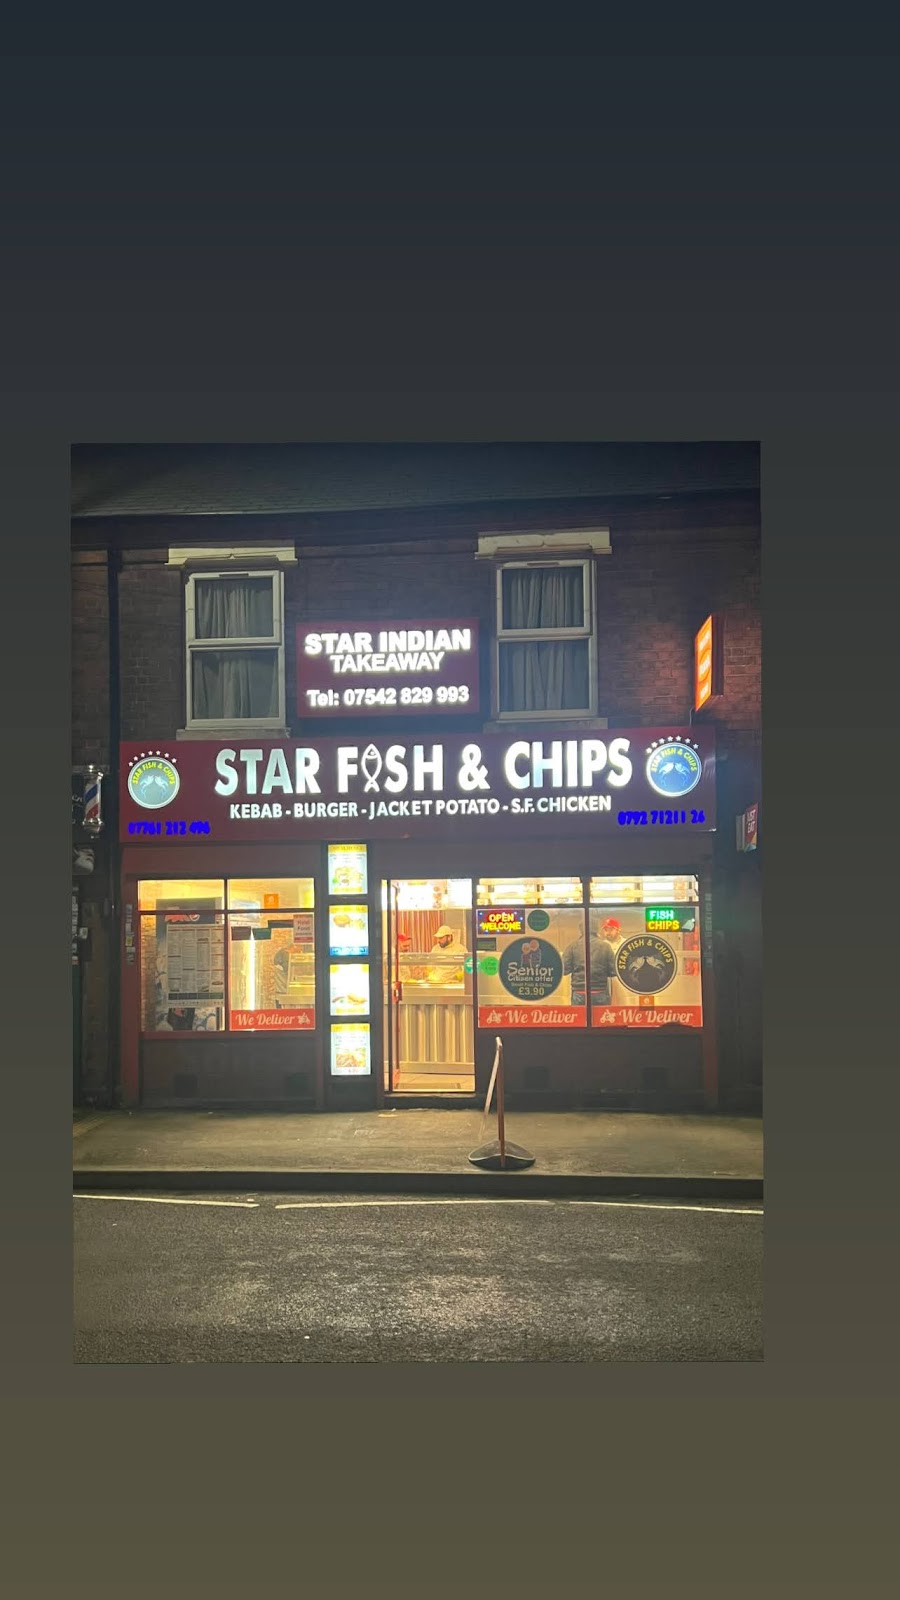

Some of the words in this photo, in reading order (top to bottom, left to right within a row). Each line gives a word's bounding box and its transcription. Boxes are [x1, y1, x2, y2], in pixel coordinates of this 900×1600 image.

[305, 632, 373, 654] STAR
[379, 629, 471, 652] INDIAN
[330, 652, 445, 673] TAKEAWAY
[306, 689, 339, 707] Tel:
[343, 687, 397, 706] 07542
[400, 686, 433, 704] 829
[436, 685, 470, 704] 993
[661, 747, 676, 758] FISH
[684, 752, 698, 771] CHIPS
[132, 767, 143, 785] STAR
[142, 761, 157, 771] FISH
[163, 766, 176, 785] CHIPS
[214, 749, 321, 796] STAR
[457, 744, 490, 792] &
[503, 738, 632, 790] CHIPS
[230, 803, 282, 819] KEBAB
[293, 802, 358, 818] BURGER
[368, 800, 433, 820] JACKET
[436, 798, 500, 816] POTATO
[537, 795, 612, 813] CHICKEN
[488, 913, 514, 922] OPEN
[649, 910, 674, 920] FISH
[481, 921, 522, 931] WELCOME
[647, 920, 680, 930] CHIPS
[618, 950, 629, 970] STAR
[627, 939, 645, 951] FISH
[654, 942, 673, 963] CHIPS
[507, 961, 554, 976] Senior
[518, 986, 545, 996] £3.90
[235, 1013, 254, 1026] We
[256, 1012, 295, 1025] Deliver
[505, 1010, 529, 1024] We
[531, 1010, 578, 1024] Deliver
[619, 1010, 642, 1024] We
[645, 1009, 693, 1023] Deliver
